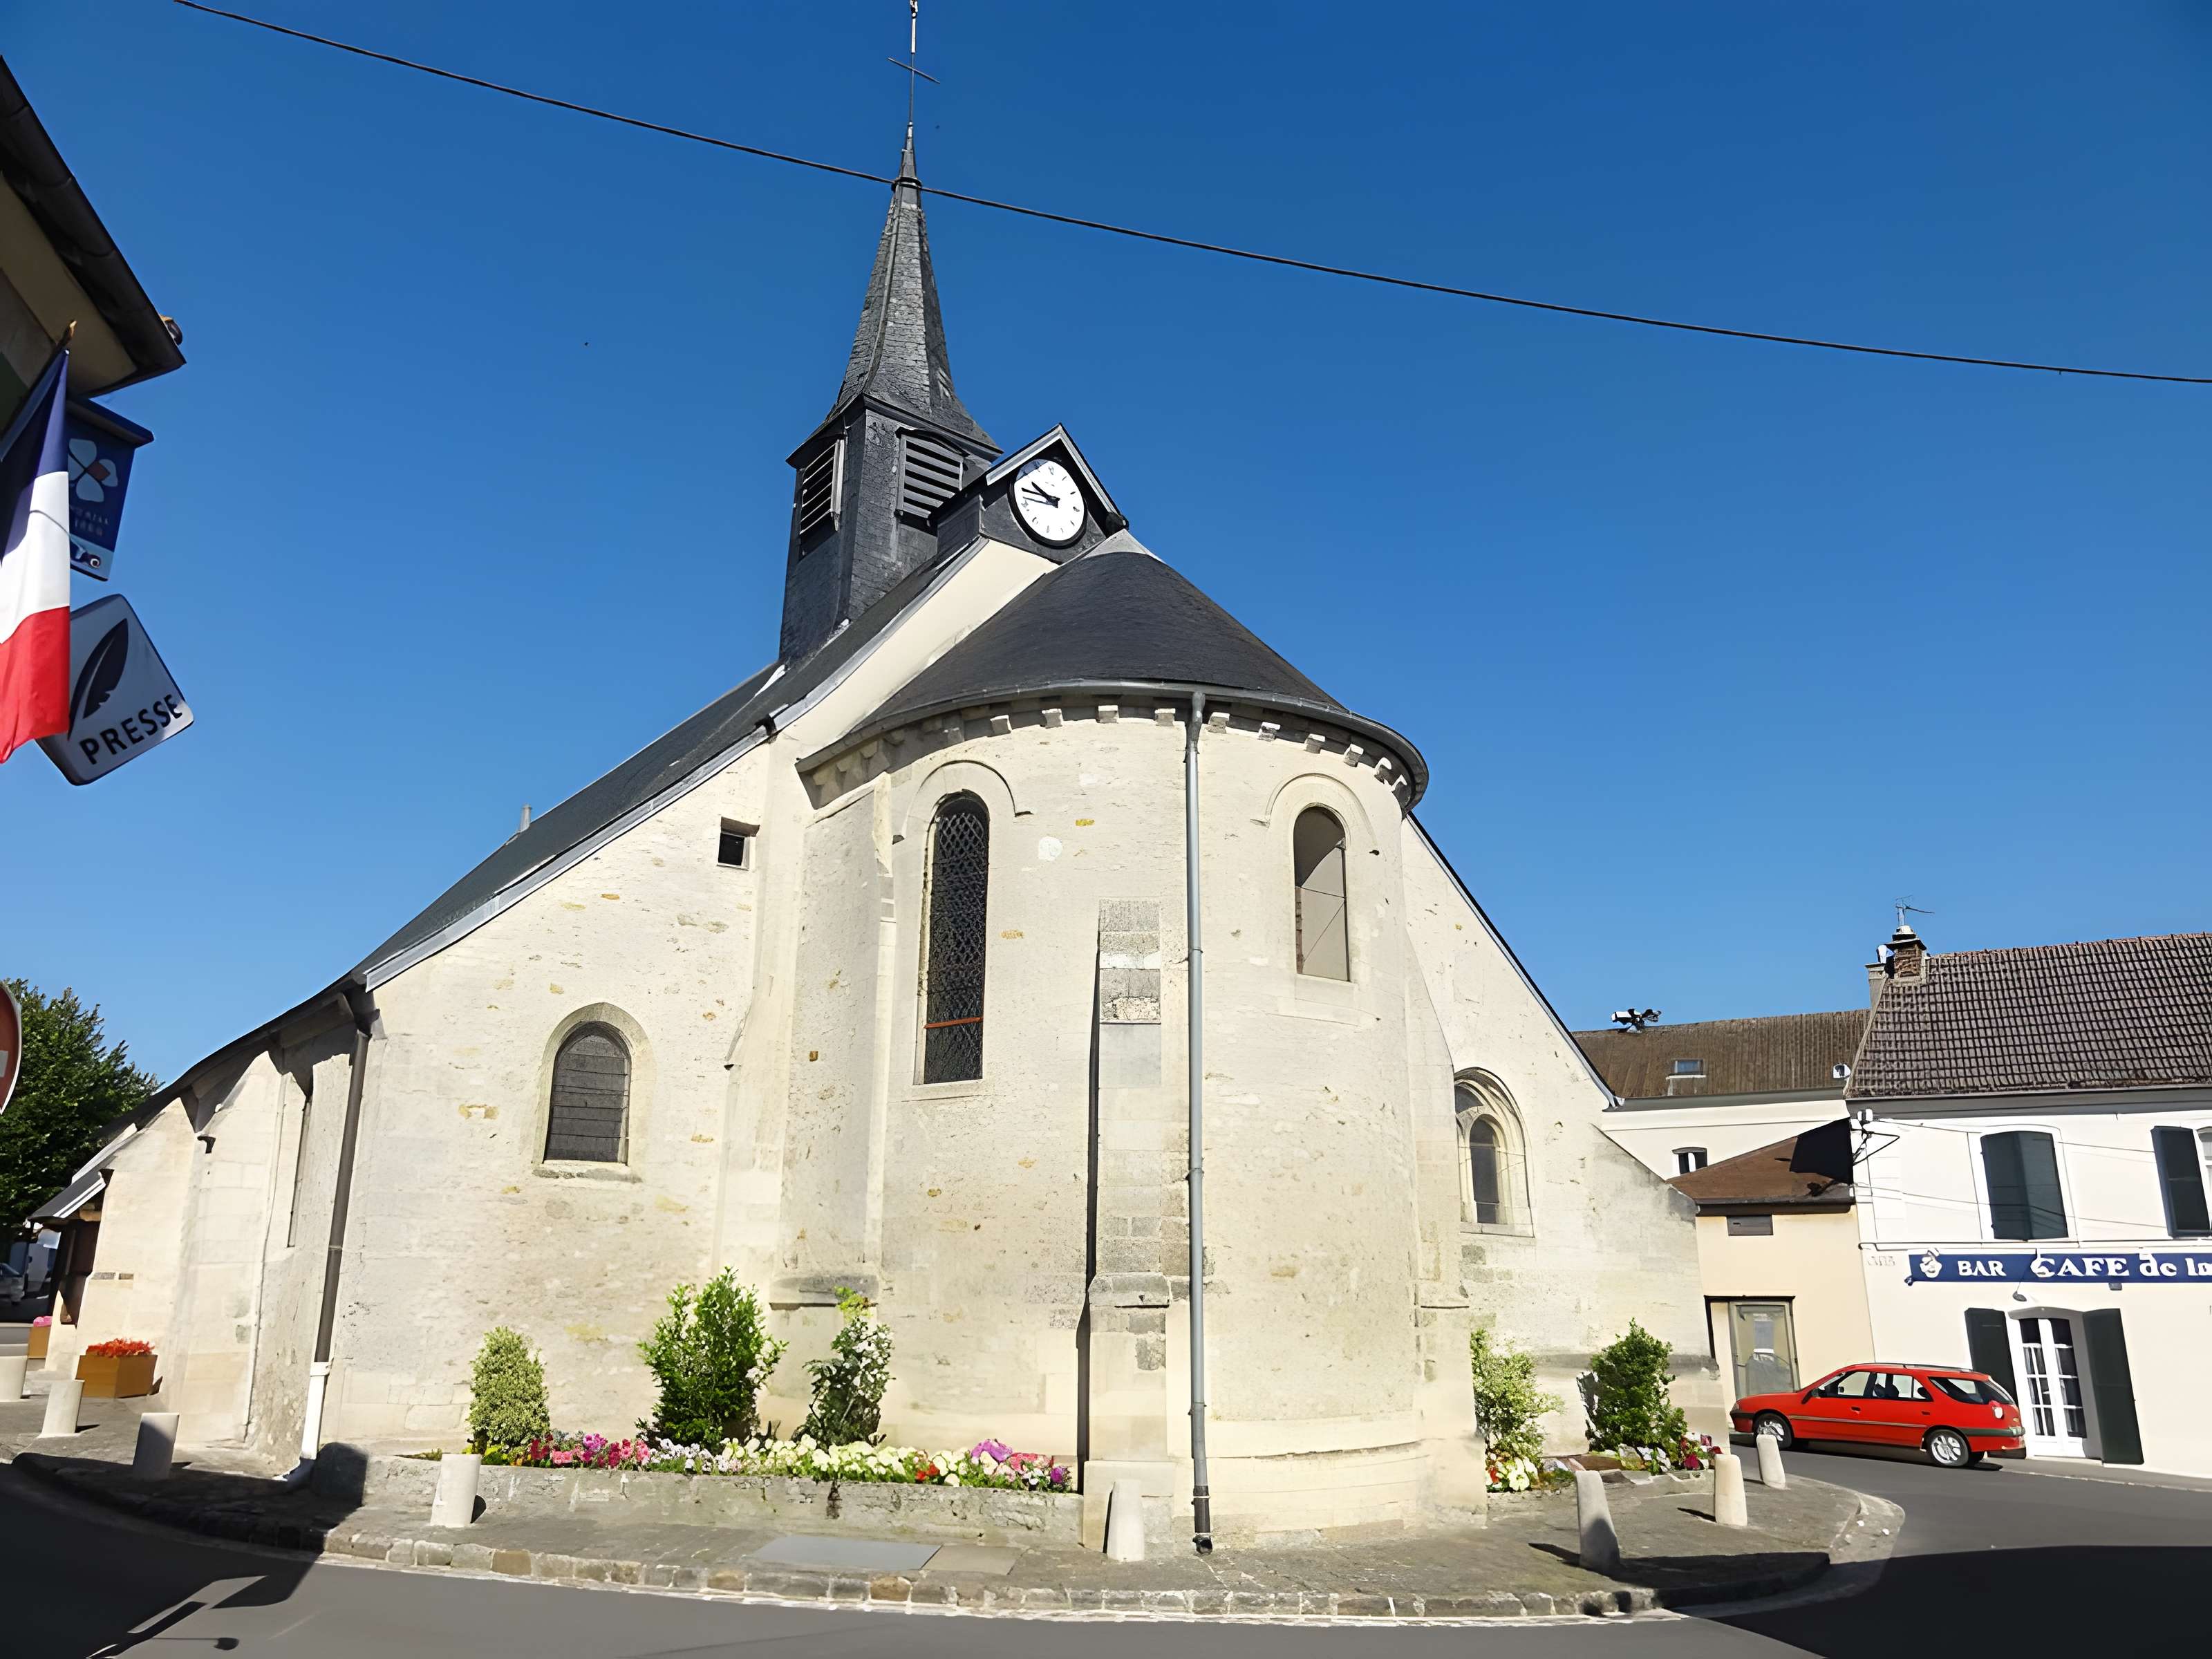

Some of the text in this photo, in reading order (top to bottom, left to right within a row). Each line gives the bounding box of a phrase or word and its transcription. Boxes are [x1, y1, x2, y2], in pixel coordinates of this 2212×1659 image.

[79, 694, 182, 765] PRESSE
[1958, 1260, 2007, 1277] BAR
[2030, 1257, 2130, 1277] CAFE
[2139, 1253, 2177, 1277] de
